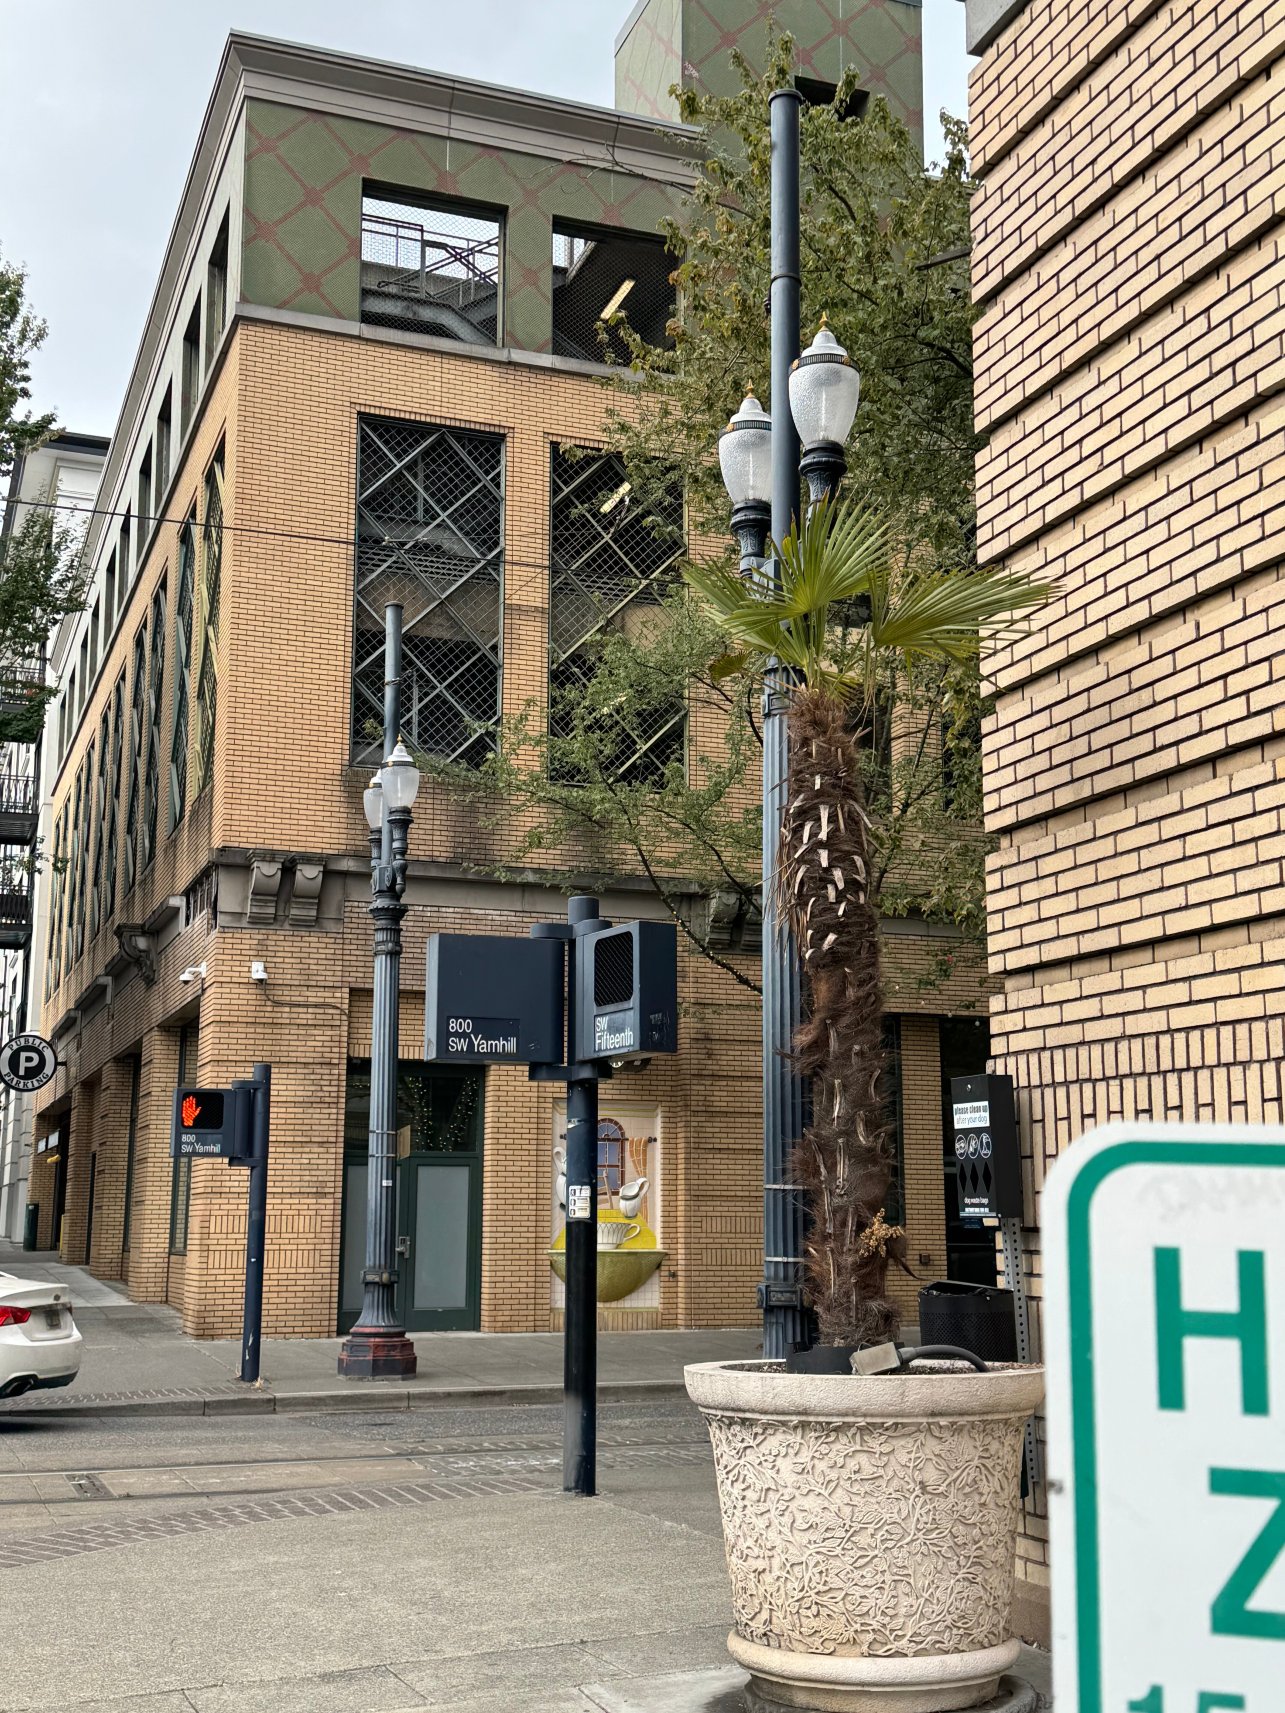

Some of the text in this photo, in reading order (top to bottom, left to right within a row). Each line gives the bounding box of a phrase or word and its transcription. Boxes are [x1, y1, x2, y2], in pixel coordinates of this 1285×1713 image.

[449, 1019, 473, 1033] 800
[596, 1016, 608, 1031] SW
[8, 1037, 49, 1052] PUBLIC
[448, 1034, 517, 1053] SW Yamhill
[595, 1027, 634, 1051] Fifteenth
[19, 1052, 40, 1076] P
[4, 1071, 49, 1089] PARKING
[955, 1106, 969, 1116] please
[969, 1104, 982, 1114] clean
[977, 1114, 988, 1125] dog
[181, 1134, 196, 1143] 800
[181, 1142, 221, 1153] SW Yamhill
